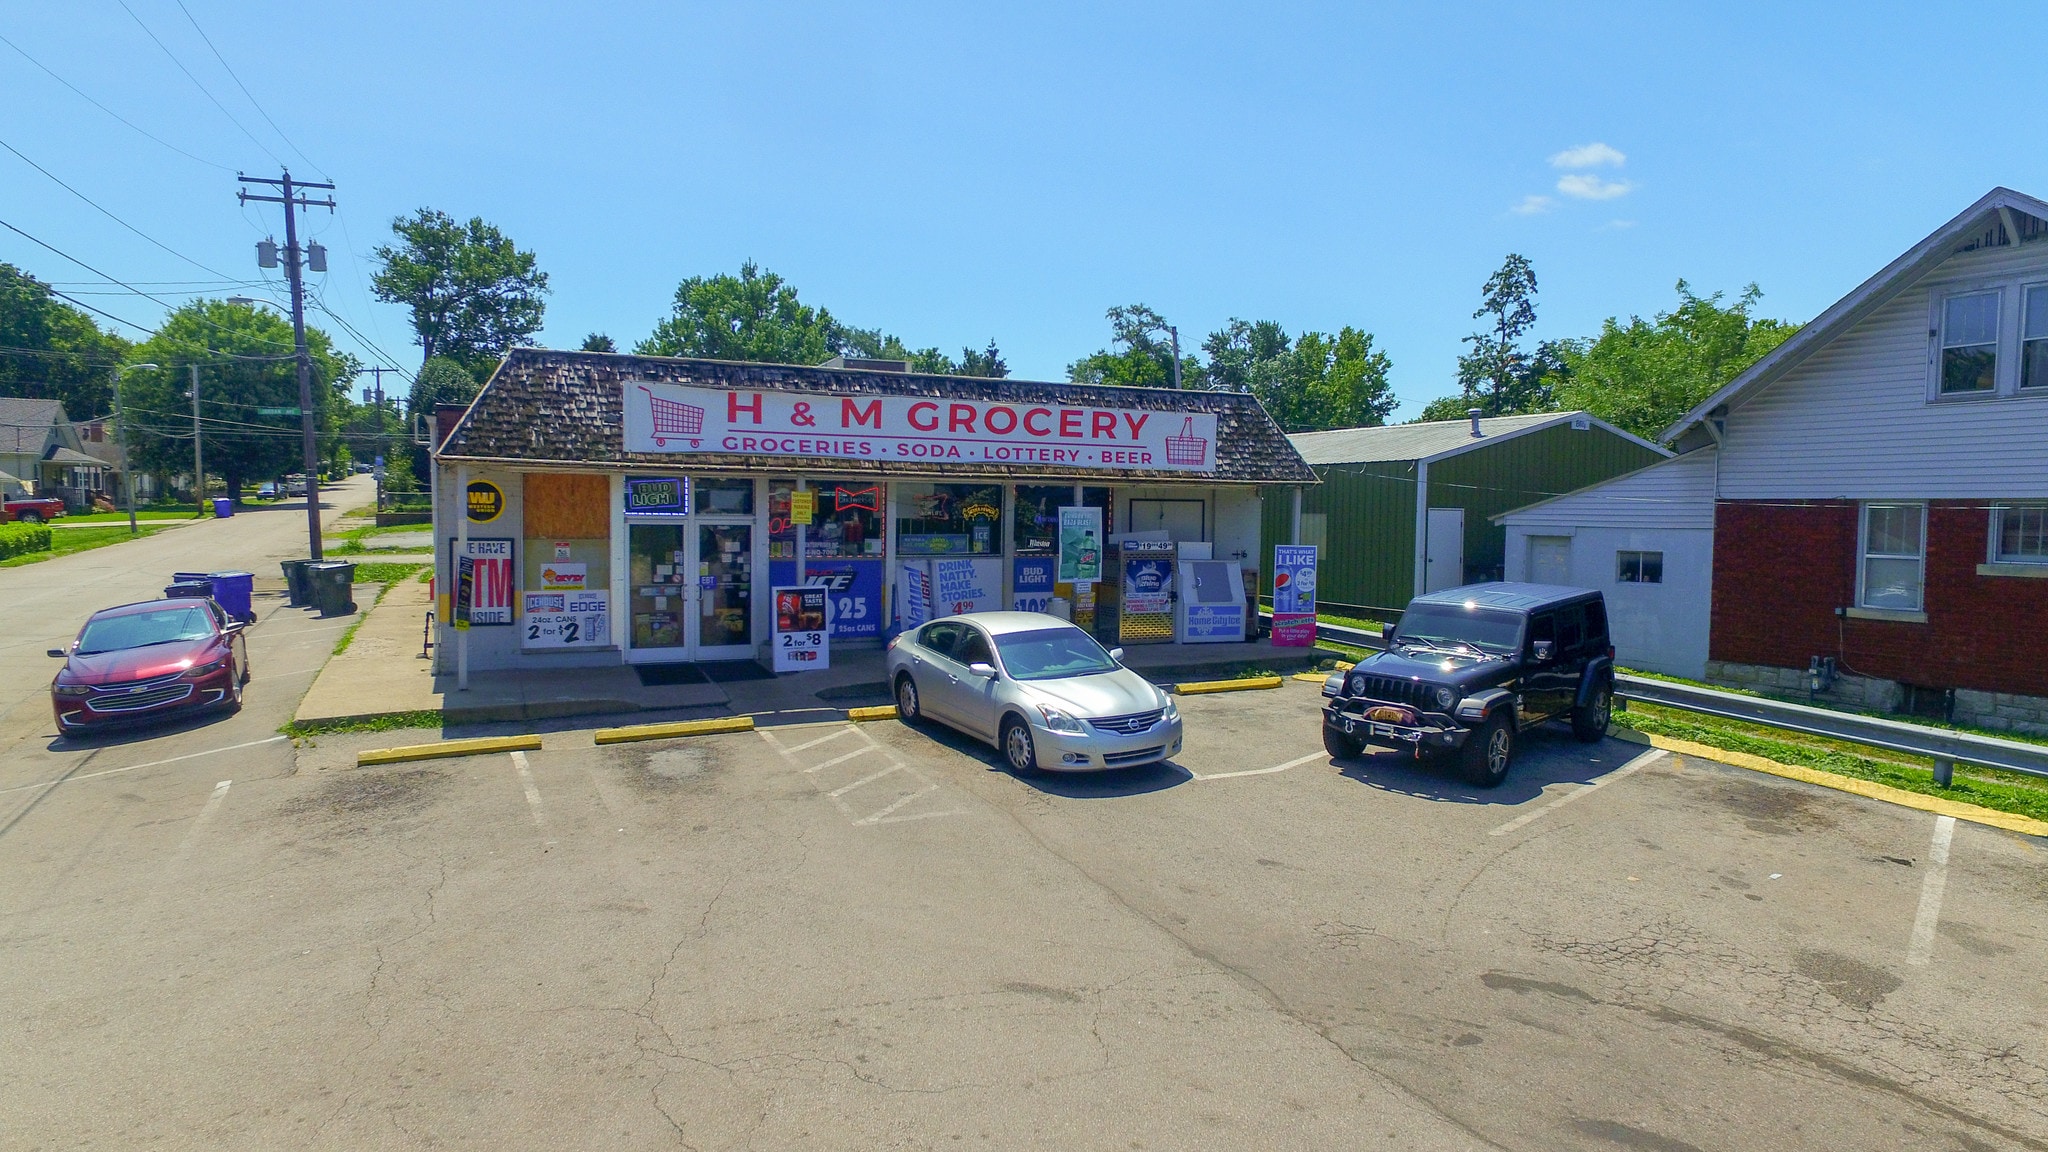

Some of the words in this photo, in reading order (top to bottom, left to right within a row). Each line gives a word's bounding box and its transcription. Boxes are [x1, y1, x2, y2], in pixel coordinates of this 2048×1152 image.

[727, 391, 762, 424] H
[790, 401, 816, 427] &
[841, 398, 883, 429] M
[907, 402, 1149, 440] GROCERY
[722, 436, 872, 455] GROCERIES
[897, 443, 961, 458] SODA
[984, 446, 1080, 462] LOTTERY
[1101, 451, 1152, 465] BEER
[639, 482, 671, 494] BUD
[467, 492, 495, 504] WU
[975, 532, 988, 540] ICE
[479, 543, 505, 554] HAVE
[938, 559, 974, 572] DRINK
[1286, 555, 1314, 565] LIKE
[940, 569, 978, 582] NATTY.
[1023, 567, 1044, 576] BUD
[702, 576, 715, 584] EBT
[1019, 575, 1048, 584] LIGHT
[920, 571, 931, 607] LIGHT
[941, 580, 972, 592] MAKE
[942, 588, 986, 602] STORIES.
[527, 596, 564, 608] ICEHOUSE
[570, 601, 606, 612] EDGE
[1188, 616, 1212, 625] Home
[1212, 616, 1227, 627] City
[1228, 616, 1240, 625] Ice
[528, 624, 541, 640] 2
[783, 635, 793, 647] 2
[806, 632, 821, 645] $8
